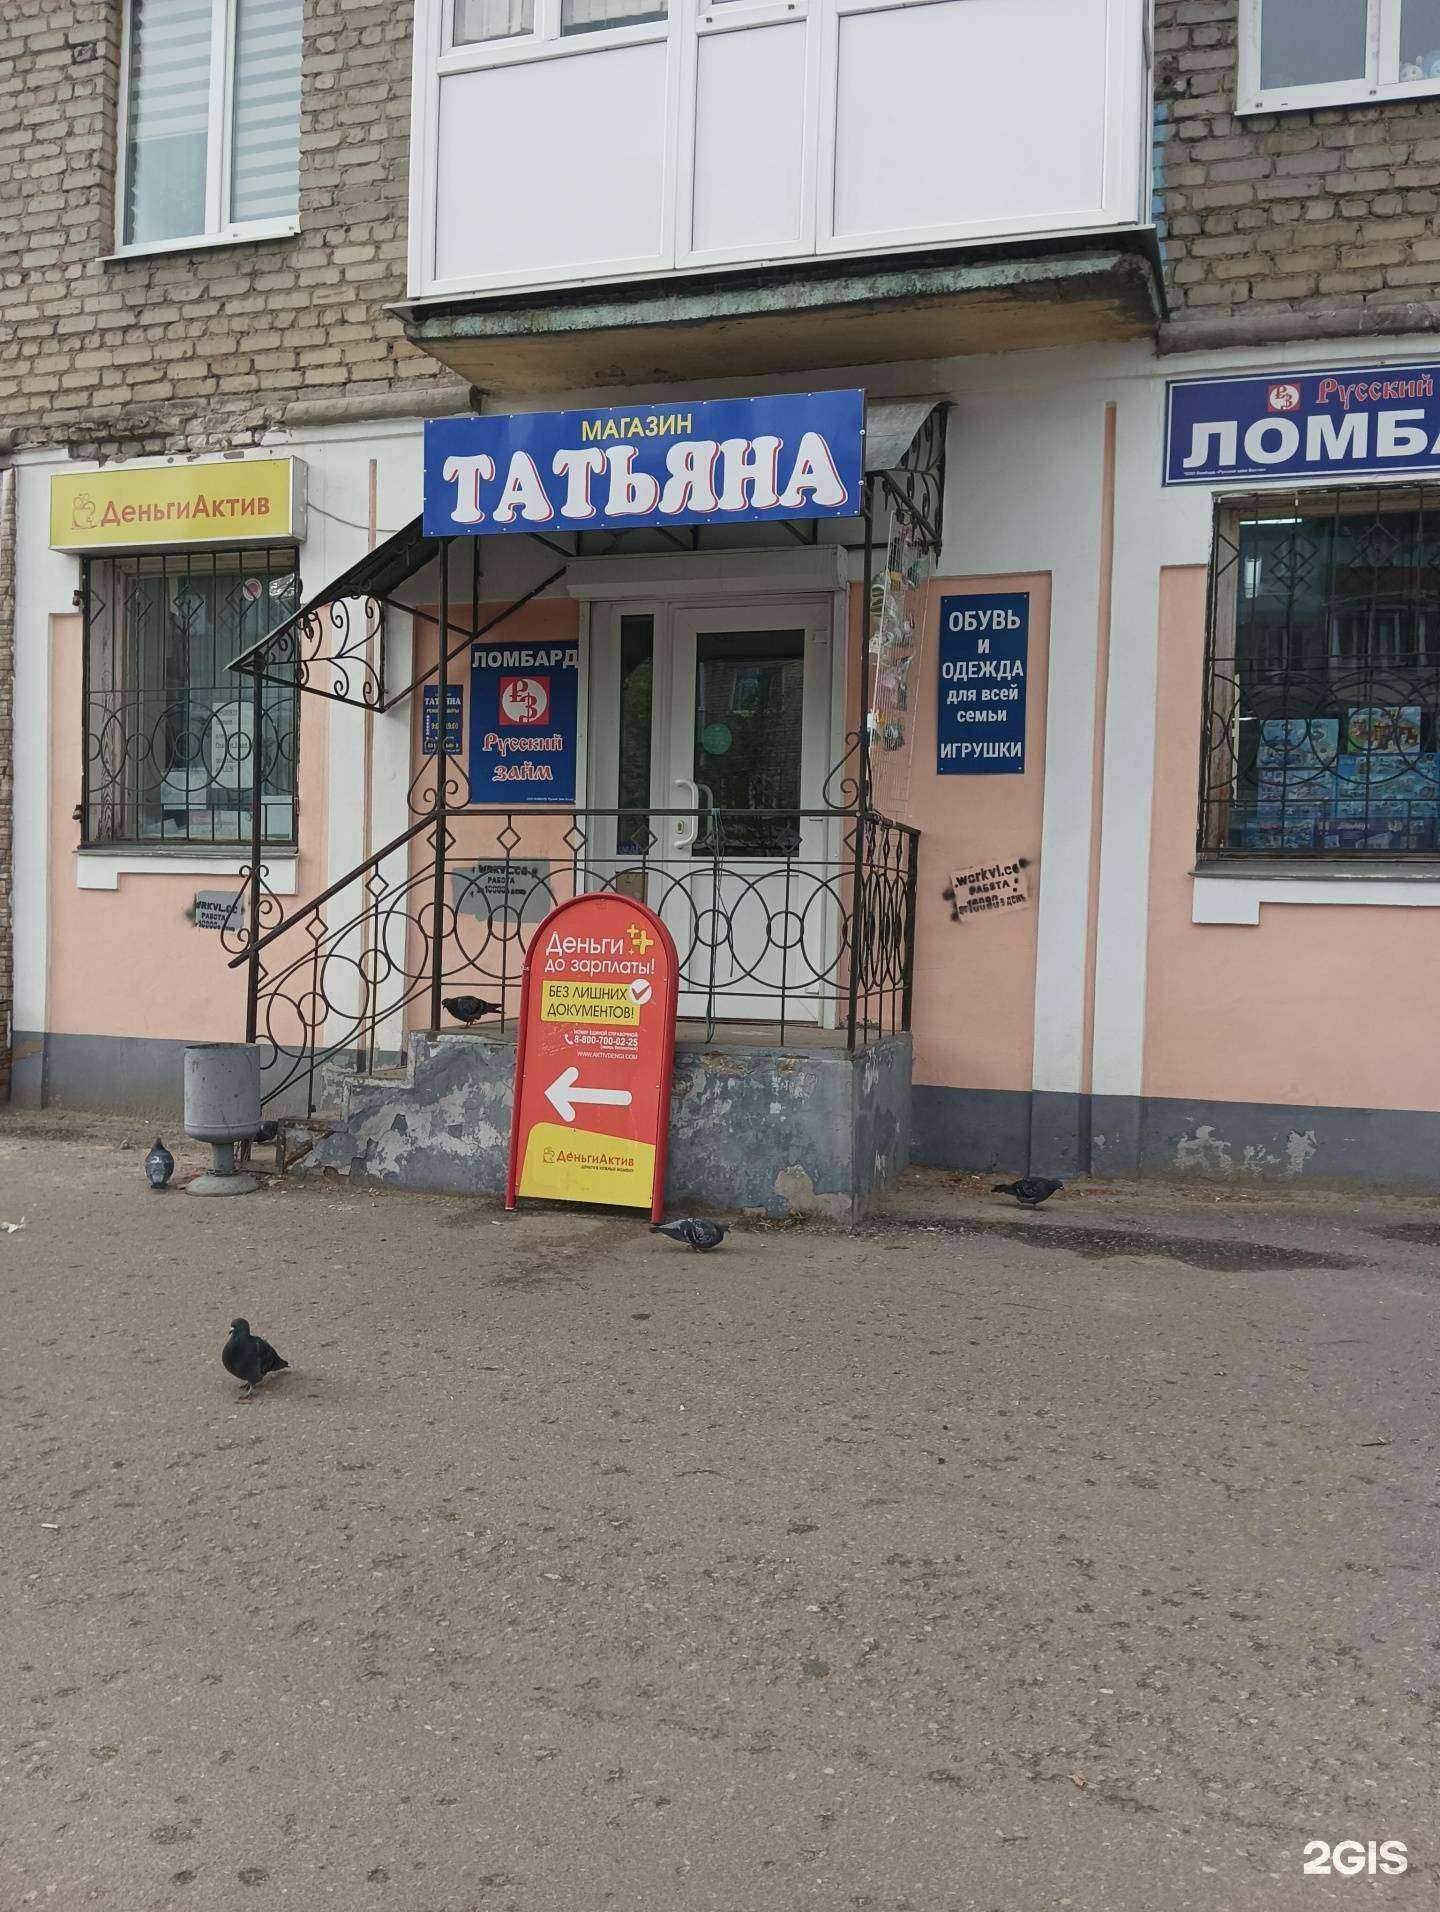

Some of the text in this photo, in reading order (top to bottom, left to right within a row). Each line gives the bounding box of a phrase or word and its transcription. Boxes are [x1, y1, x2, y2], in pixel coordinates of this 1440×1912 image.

[1315, 374, 1434, 410] Русский
[582, 413, 692, 441] МАГАЗИН
[1182, 409, 1440, 469] ЛОМБ
[442, 431, 848, 523] ТАТЬЯНА
[100, 494, 271, 527] ДеньгиАктив
[949, 609, 1021, 632] ОБУВЬ
[472, 650, 580, 669] ЛОМБАРД
[942, 660, 1024, 682] ОДЕЖДА
[946, 683, 1018, 704] для всей
[957, 709, 1007, 723] семьи
[482, 732, 563, 757] Русский
[940, 741, 1022, 759] ИГРУШКИ
[545, 931, 624, 957] Деньги
[570, 958, 656, 976] зарплаты!
[549, 985, 627, 1001] БЕЗ ЛИШНИХ
[547, 1003, 634, 1019] ДОКУМЕНТОВ!
[557, 1150, 634, 1166] ДеньгиАктив
